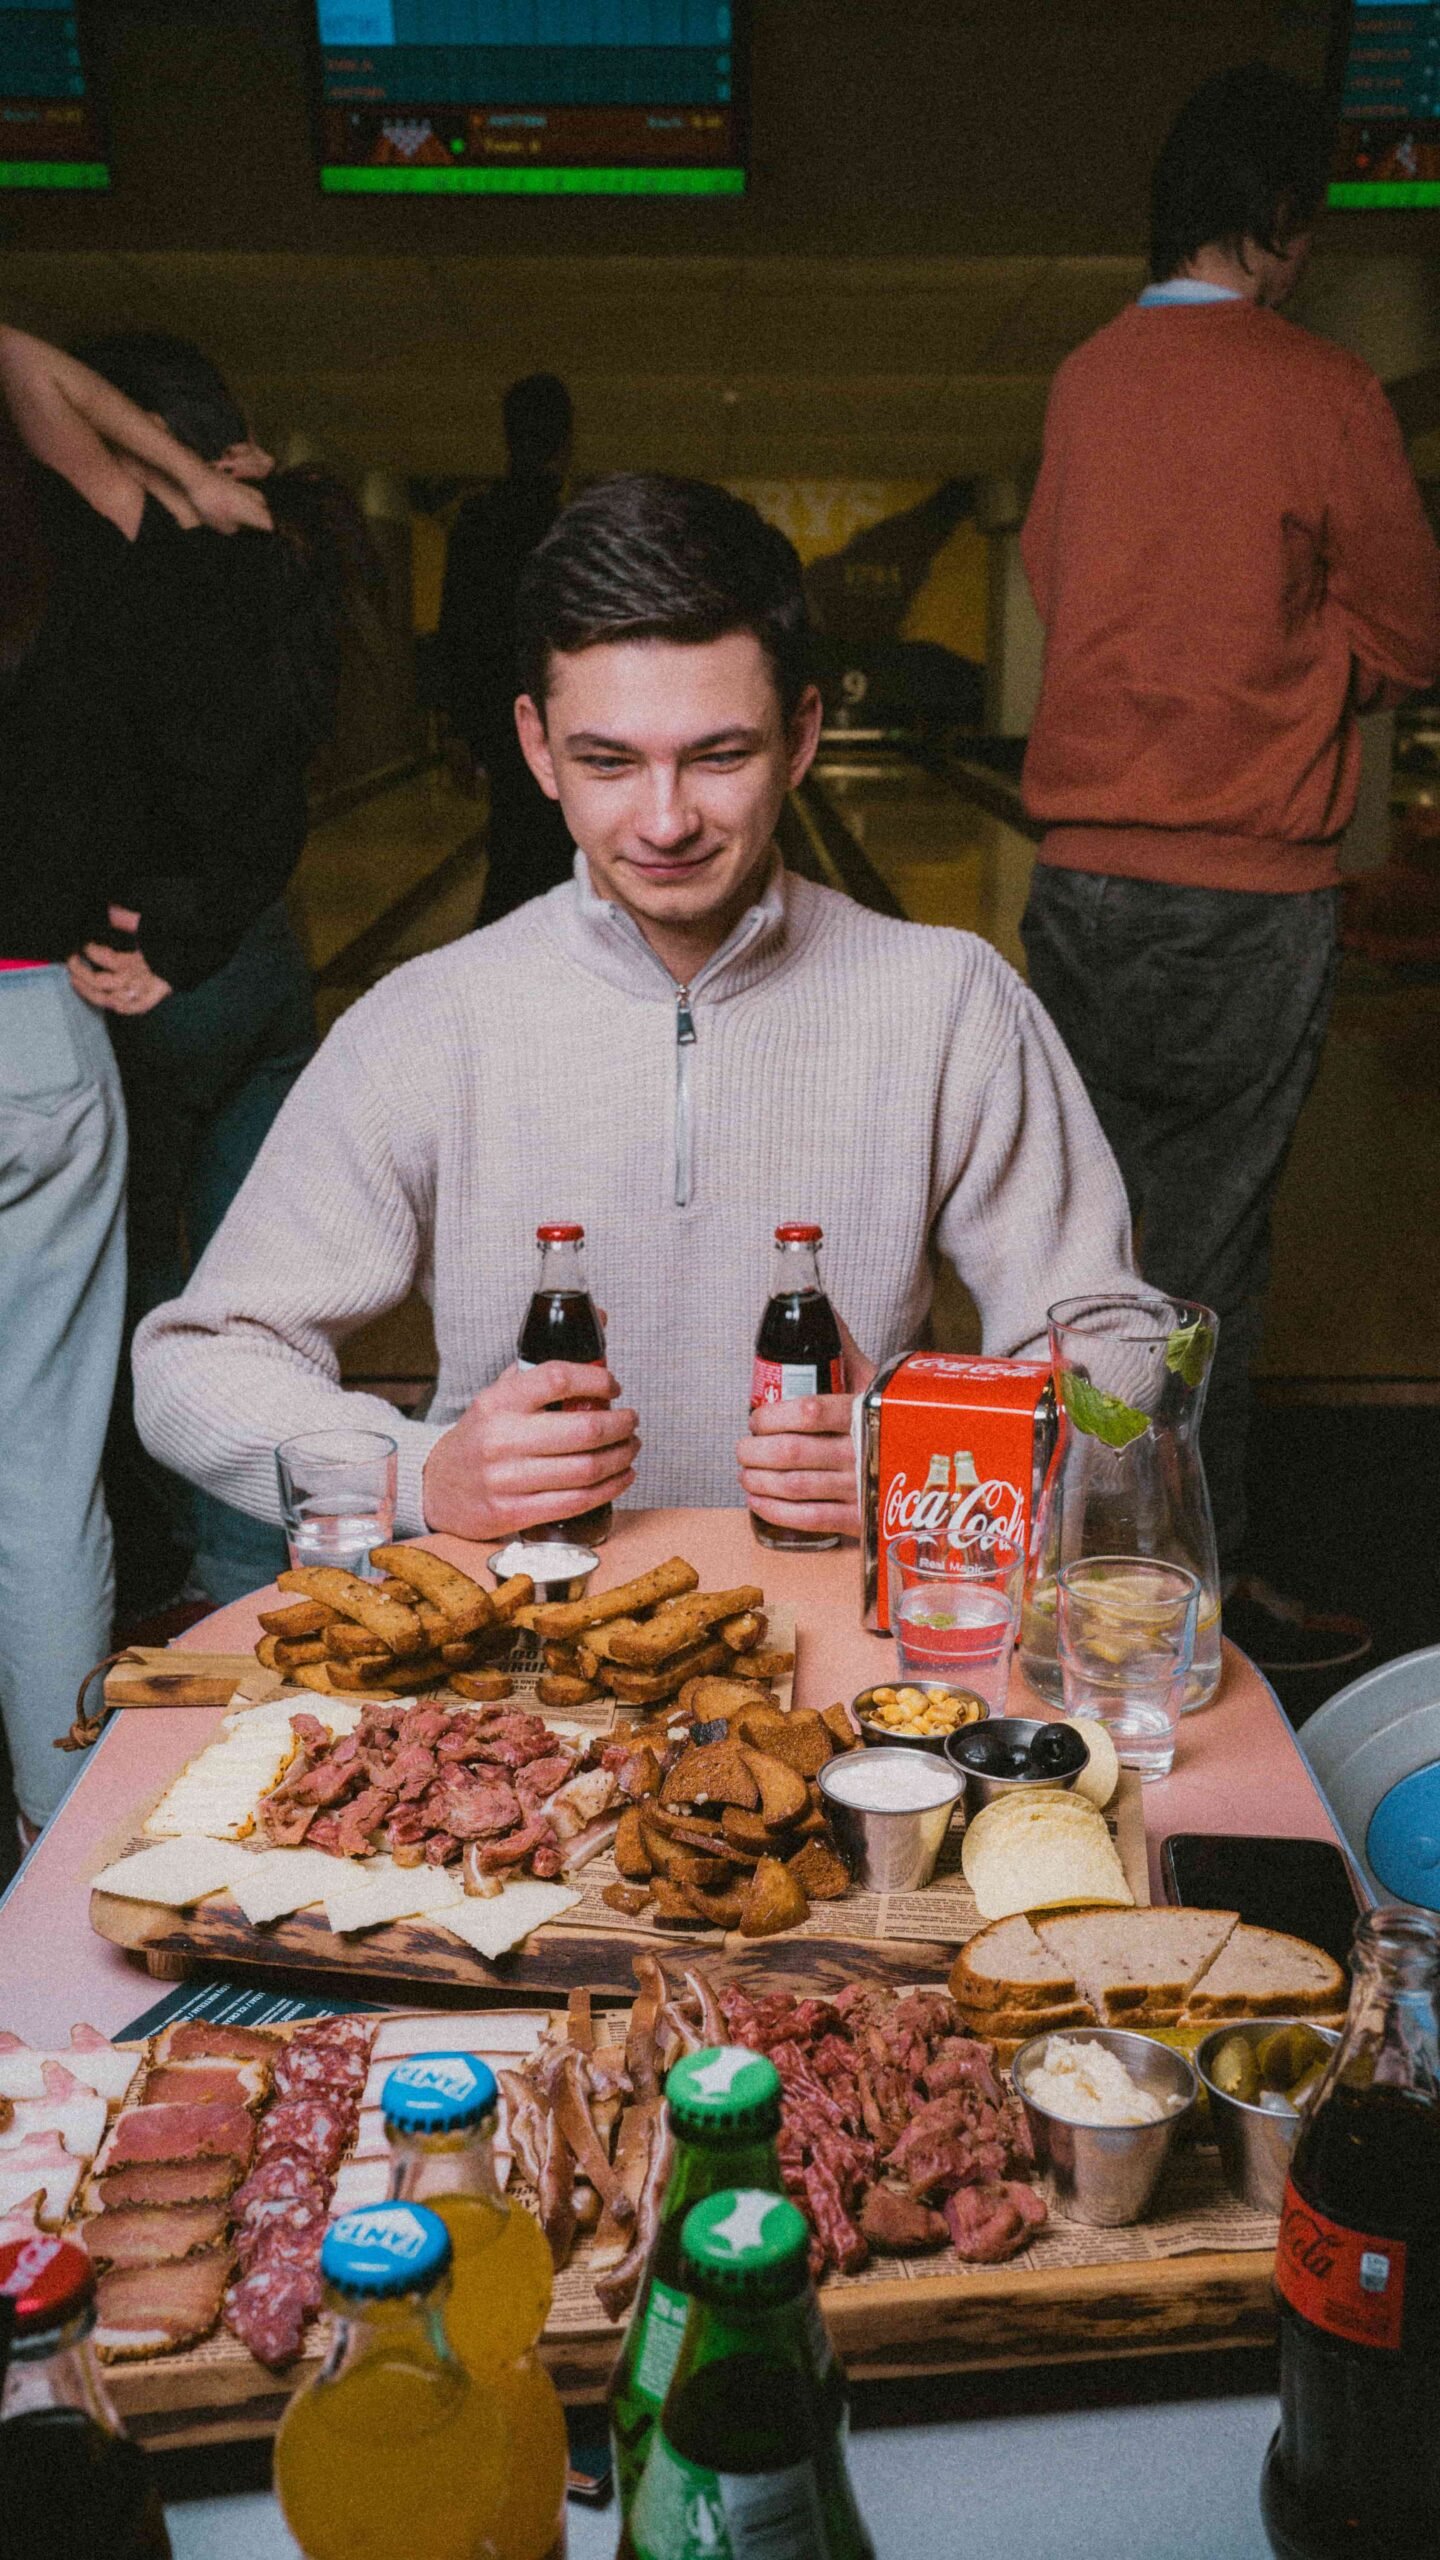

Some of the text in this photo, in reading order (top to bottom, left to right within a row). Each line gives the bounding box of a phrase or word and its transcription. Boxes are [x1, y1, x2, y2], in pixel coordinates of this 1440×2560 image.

[843, 670, 867, 701] 9
[908, 1357, 1042, 1378] Coca-Cola
[919, 1557, 945, 1571] Real
